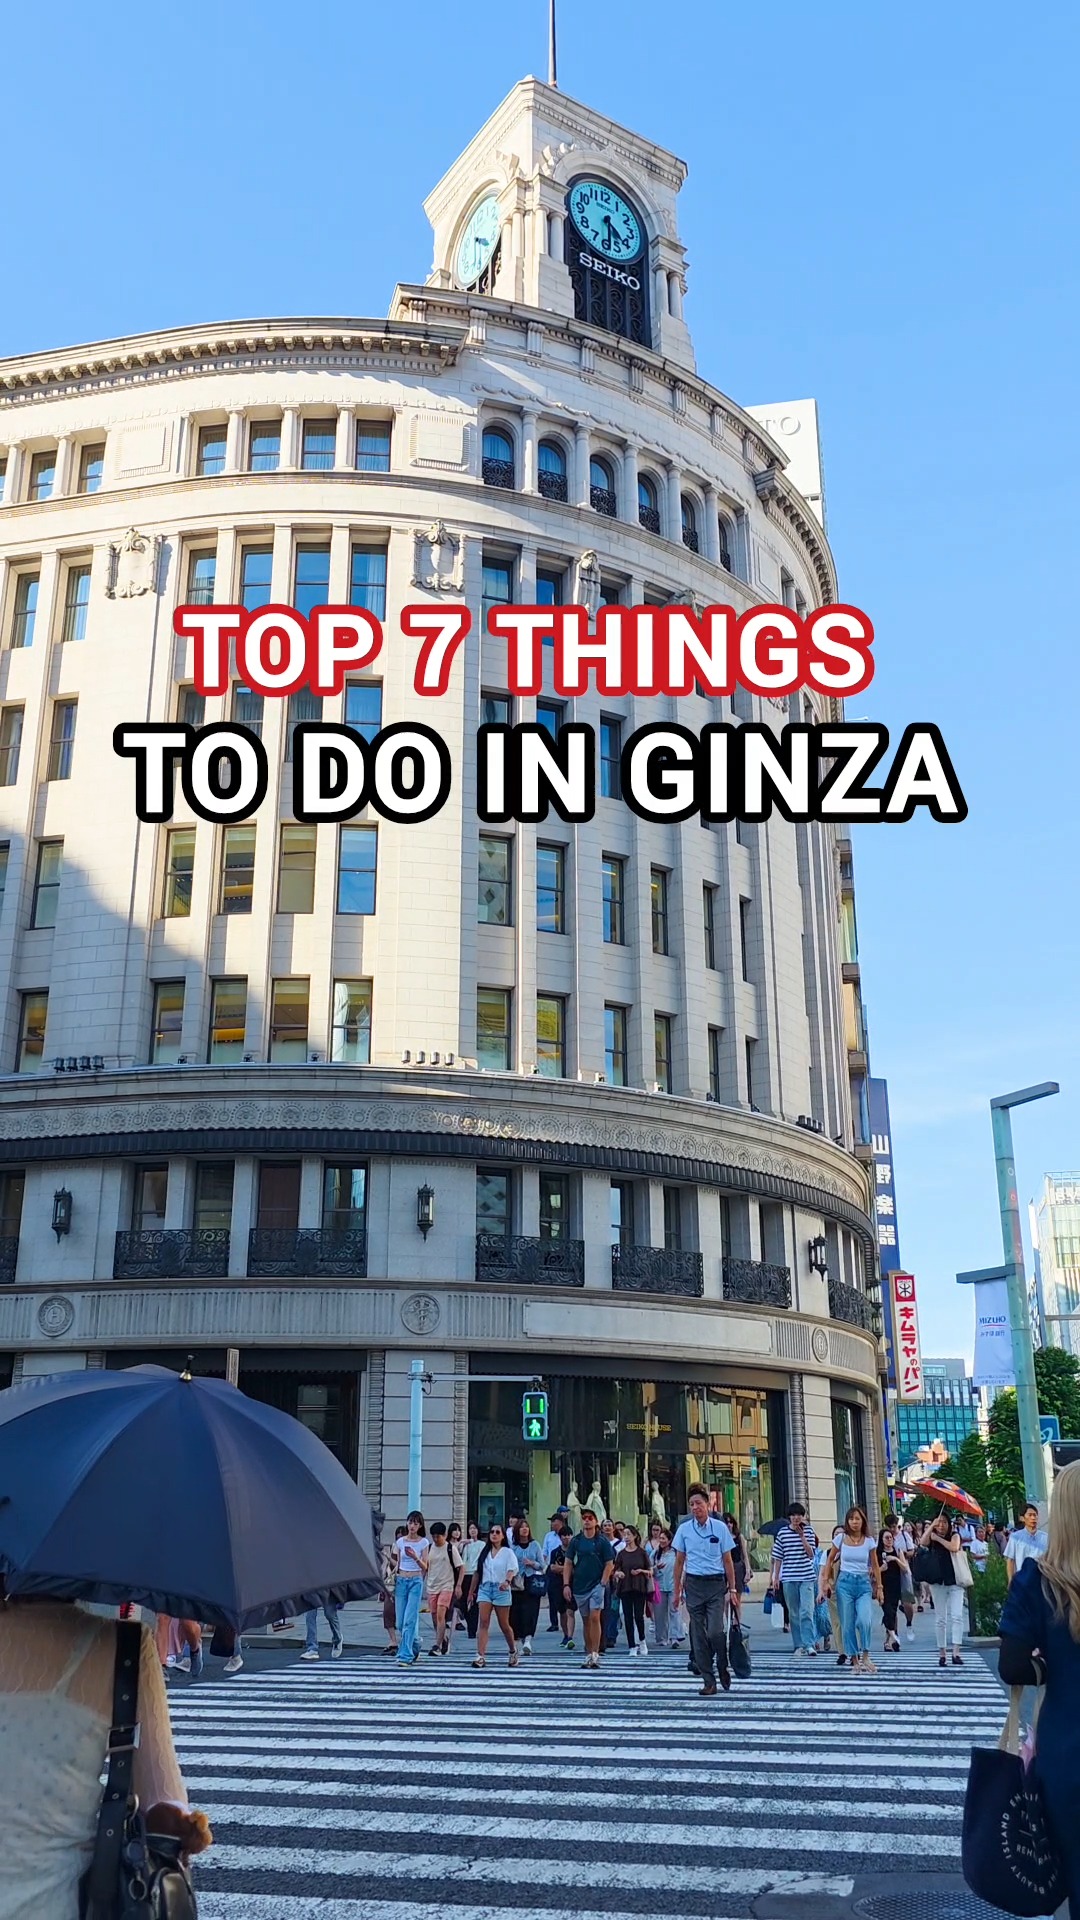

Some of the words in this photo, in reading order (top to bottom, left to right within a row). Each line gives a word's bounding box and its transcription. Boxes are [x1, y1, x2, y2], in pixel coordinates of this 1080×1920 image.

[580, 191, 590, 206] 10
[590, 188, 598, 201] 11
[600, 190, 611, 205] 12
[576, 202, 585, 214] 9
[615, 201, 619, 212] 1
[580, 216, 590, 229] 8
[622, 213, 631, 226] 2
[590, 229, 600, 241] 7
[626, 227, 635, 240] 3
[601, 239, 611, 251] 6
[613, 240, 622, 253] 5
[621, 239, 631, 250] 4
[579, 252, 641, 290] SEIKO
[872, 1134, 896, 1245] 山野楽器
[979, 1315, 1007, 1324] MIZUHO
[899, 1307, 920, 1393] キムラヤのパン
[649, 1424, 672, 1432] HUSE
[1001, 1812, 1012, 1859] ISLAND
